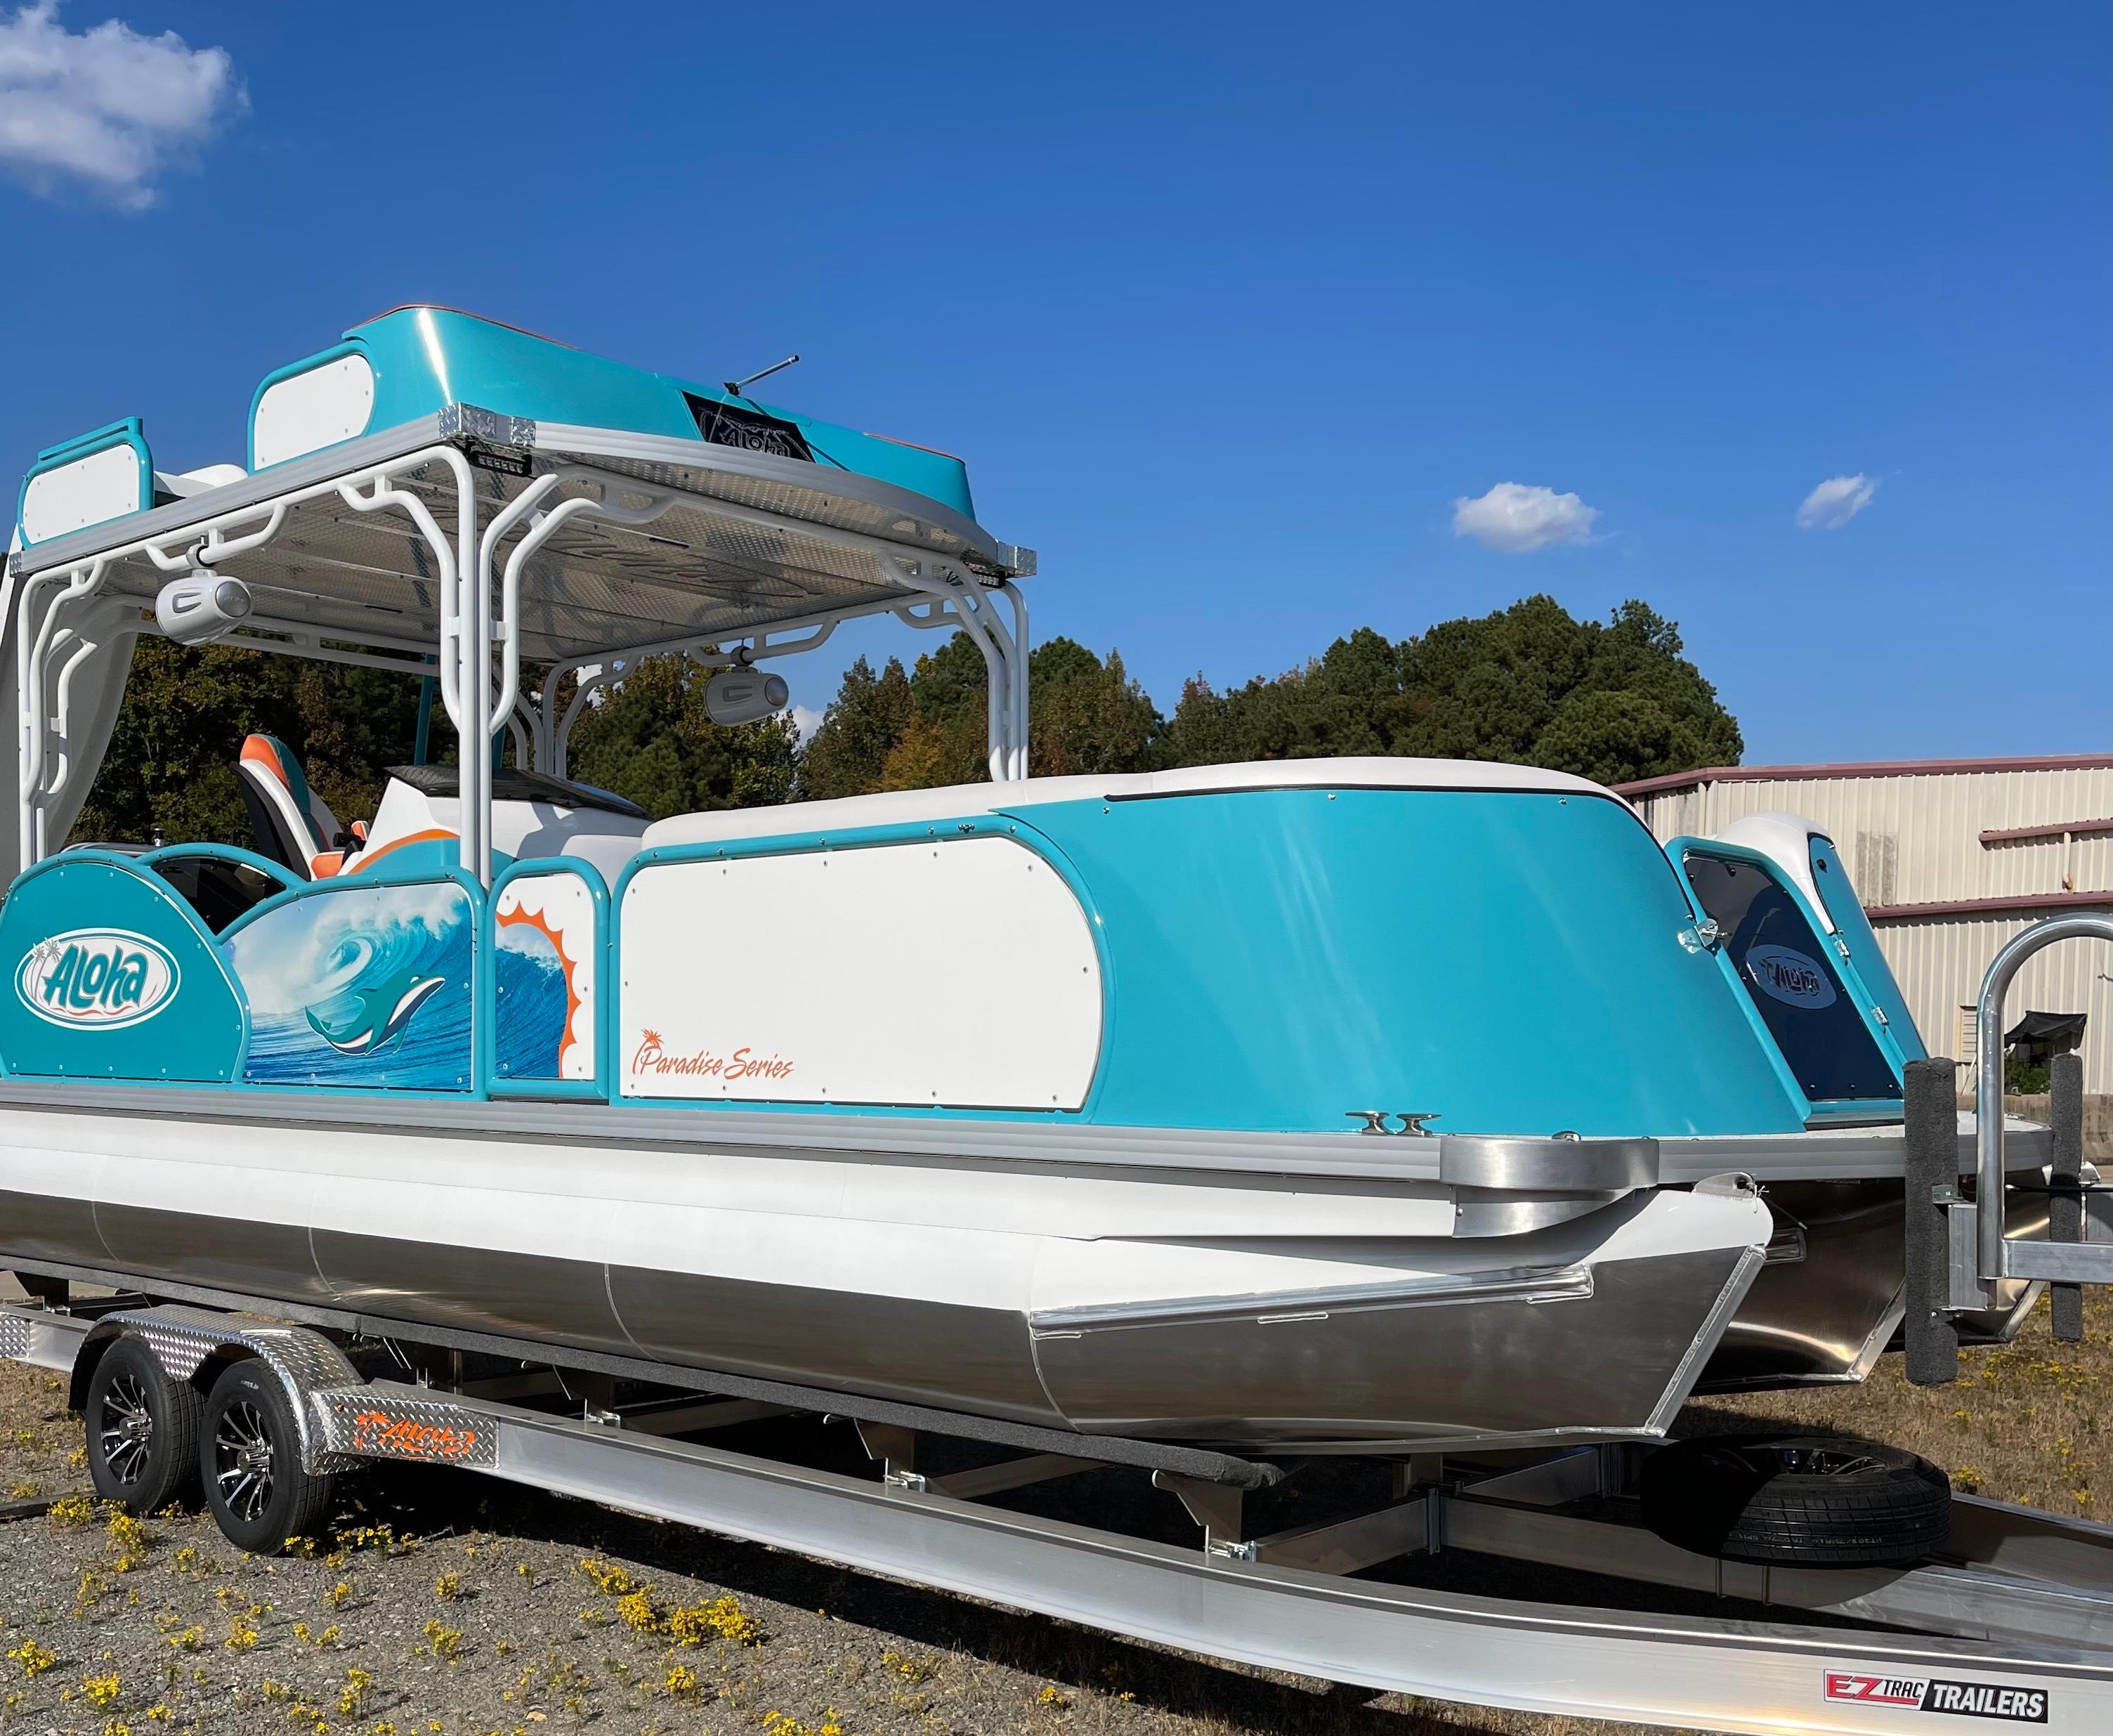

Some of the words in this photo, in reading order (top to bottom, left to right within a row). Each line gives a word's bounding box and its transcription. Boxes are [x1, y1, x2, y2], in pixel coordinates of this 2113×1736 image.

[640, 1043, 724, 1076] Paradise
[724, 1048, 795, 1080] Series
[1883, 1678, 1925, 1699] TRAC
[1932, 1683, 2045, 1718] TRAILERS
